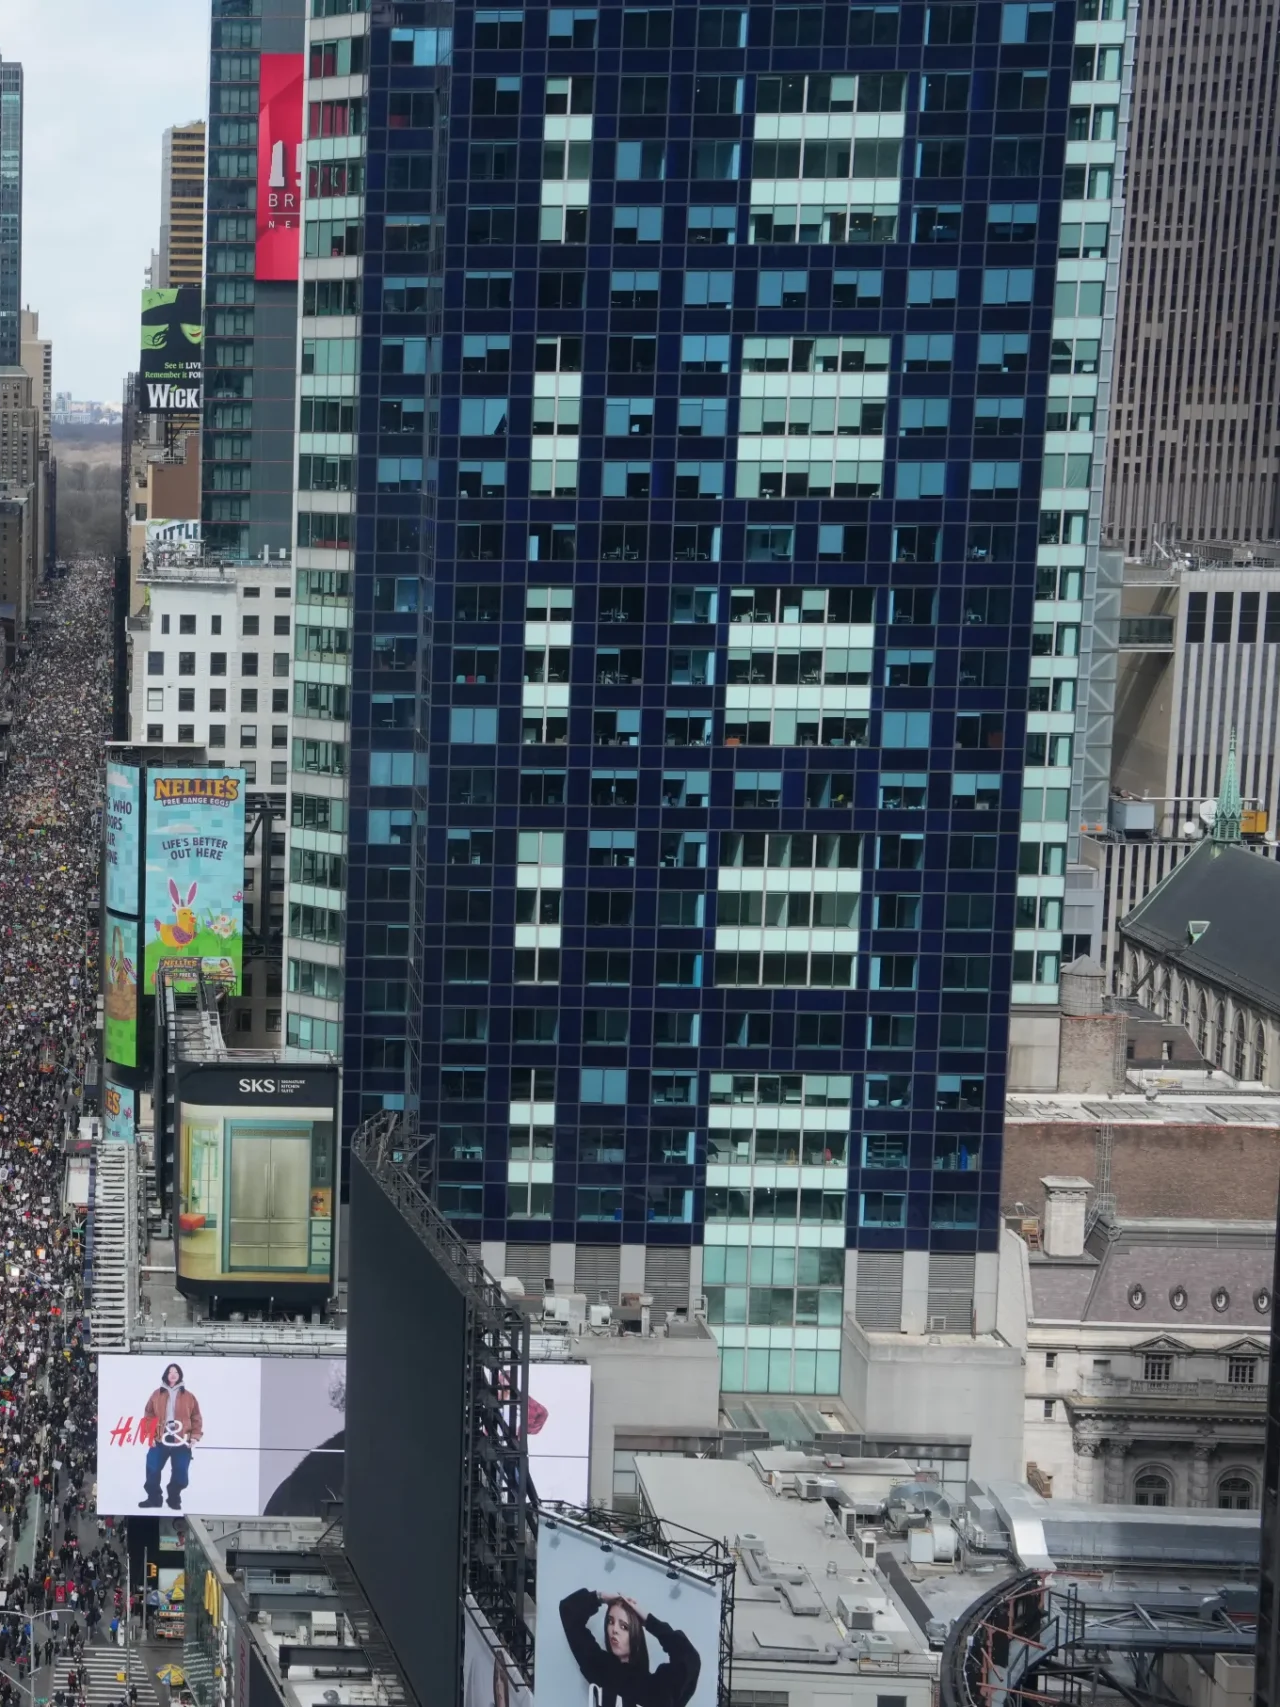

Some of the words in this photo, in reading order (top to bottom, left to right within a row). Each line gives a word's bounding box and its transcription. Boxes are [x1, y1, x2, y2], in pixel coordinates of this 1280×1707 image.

[145, 371, 181, 379] Remember
[182, 371, 188, 379] it
[154, 776, 239, 801] NELLIE'S
[113, 800, 132, 815] WHO
[162, 799, 180, 807] FREE
[182, 797, 208, 805] RANGE
[209, 798, 230, 807] EGGS
[162, 838, 189, 850] LIFE'S
[193, 837, 228, 850] BETTER
[170, 848, 191, 860] OUT
[196, 848, 223, 860] HERE
[238, 1078, 276, 1093] SKS
[110, 1416, 158, 1447] H&M
